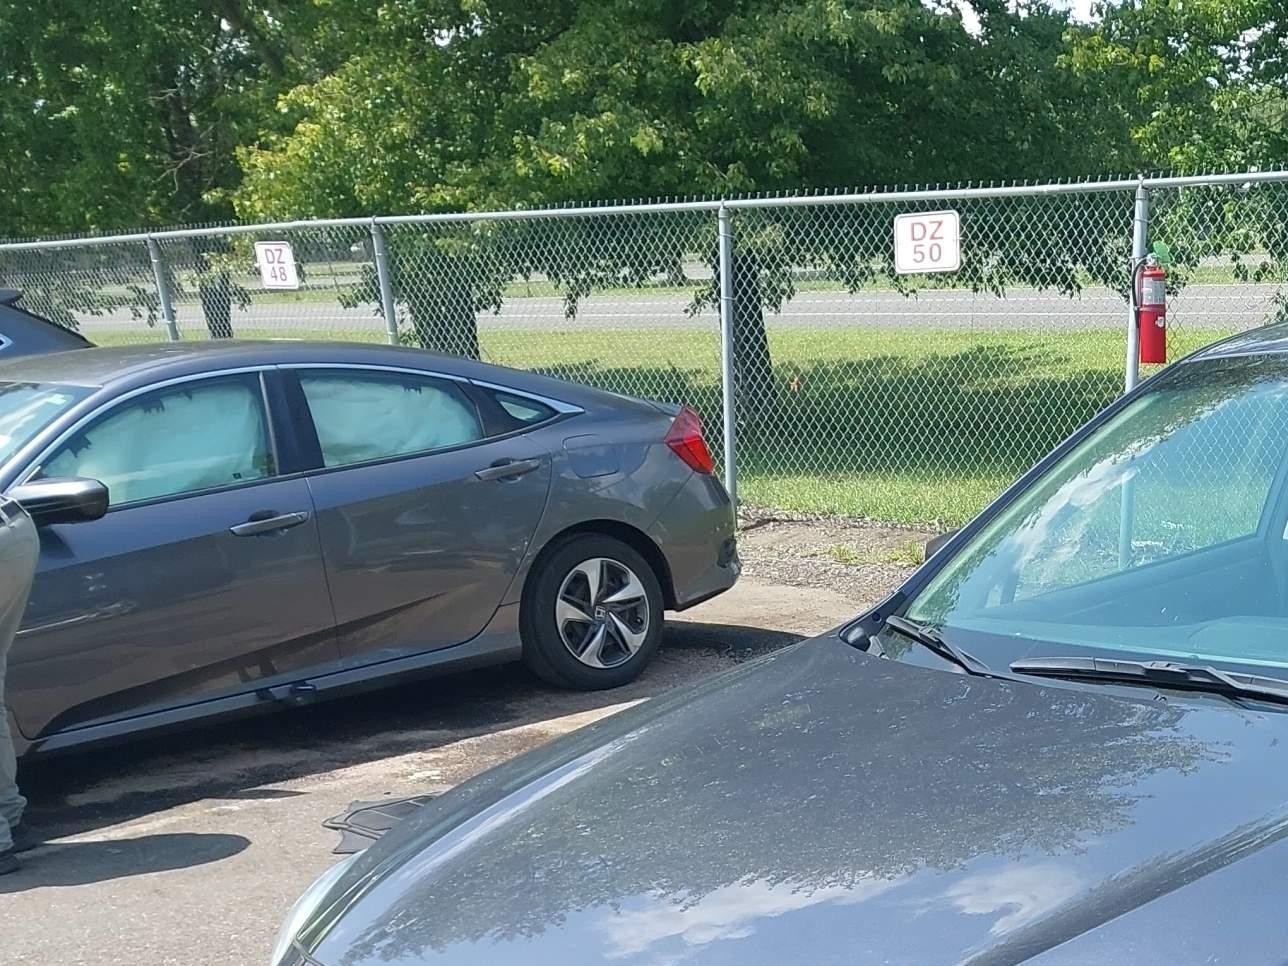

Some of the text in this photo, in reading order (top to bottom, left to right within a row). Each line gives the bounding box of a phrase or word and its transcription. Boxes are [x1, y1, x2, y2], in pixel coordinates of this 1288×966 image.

[911, 220, 944, 241] DZ
[264, 248, 286, 264] DZ
[913, 243, 942, 263] 50
[270, 265, 287, 281] 48
